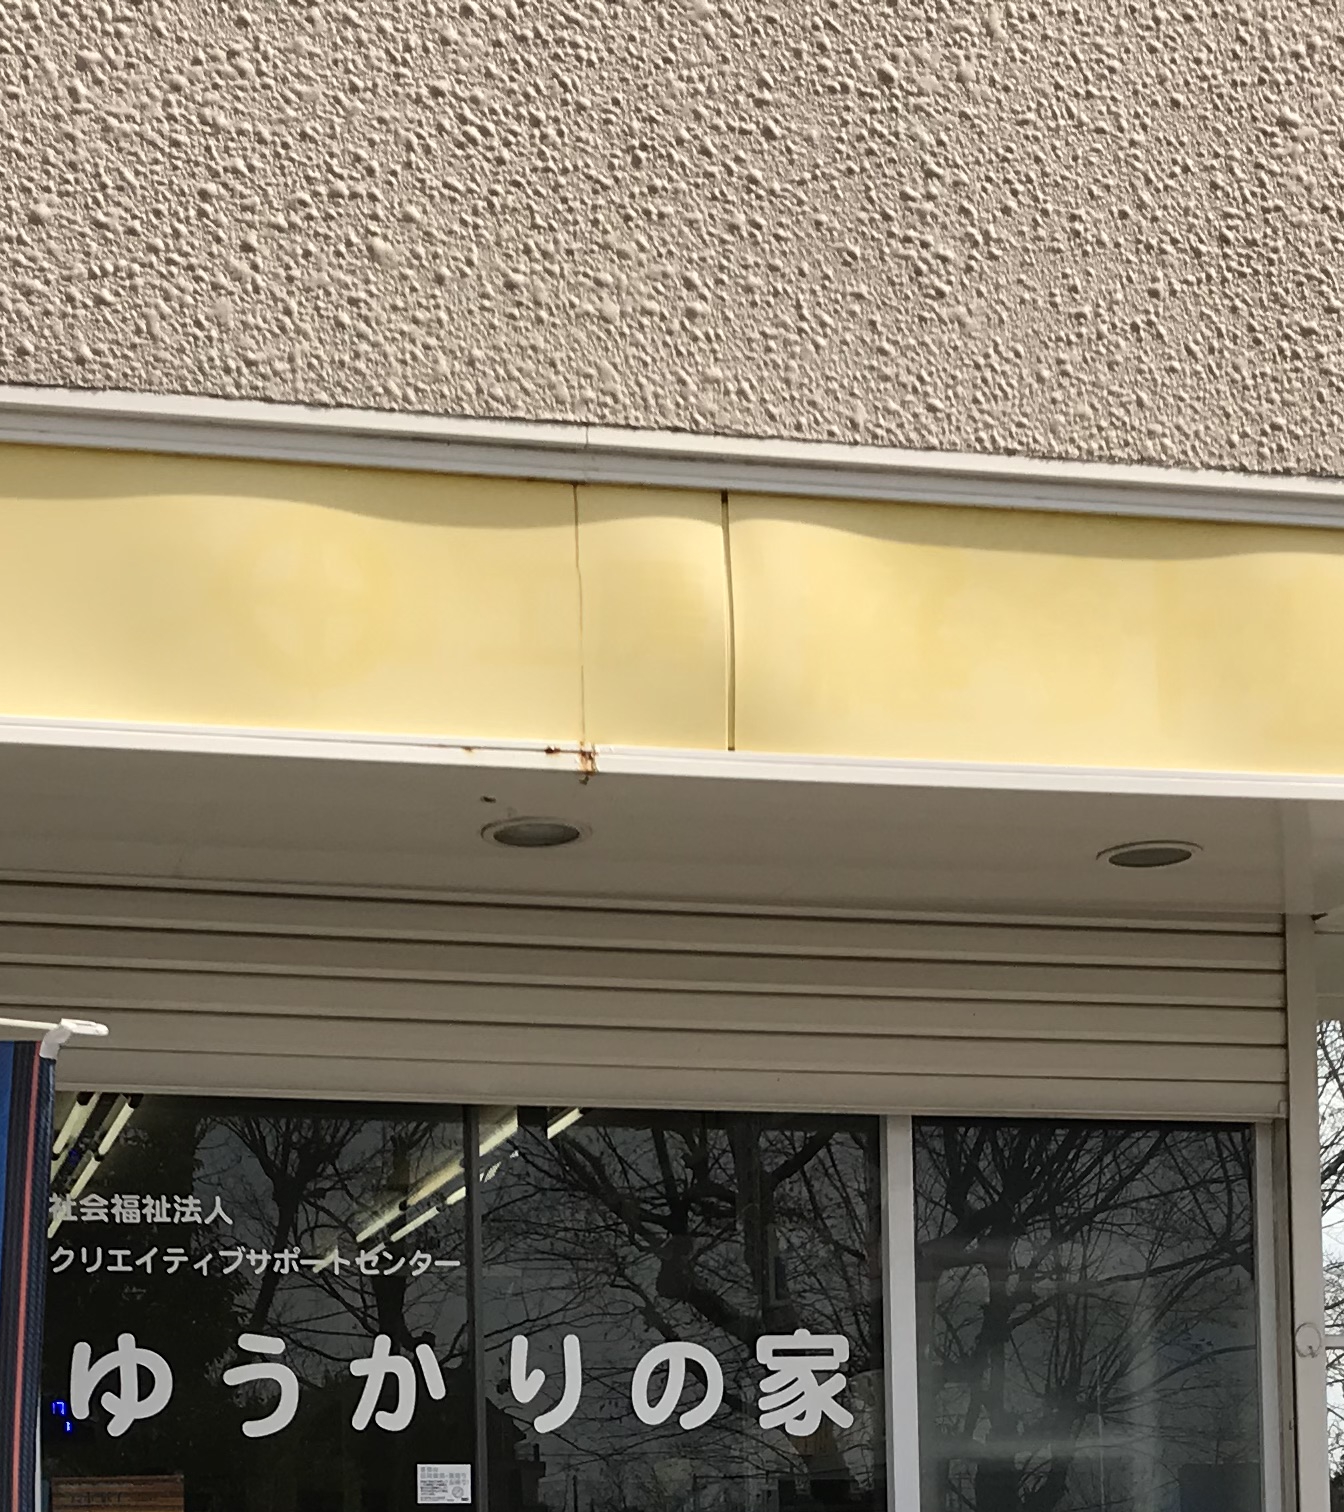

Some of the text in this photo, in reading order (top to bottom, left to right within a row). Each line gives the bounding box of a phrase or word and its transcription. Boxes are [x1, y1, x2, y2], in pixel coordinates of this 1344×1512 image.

[48, 1194, 233, 1226] 社会福祉法人
[50, 1245, 462, 1277] クリエイティブサポートセンター
[70, 1328, 855, 1437] ゆうかりの家
